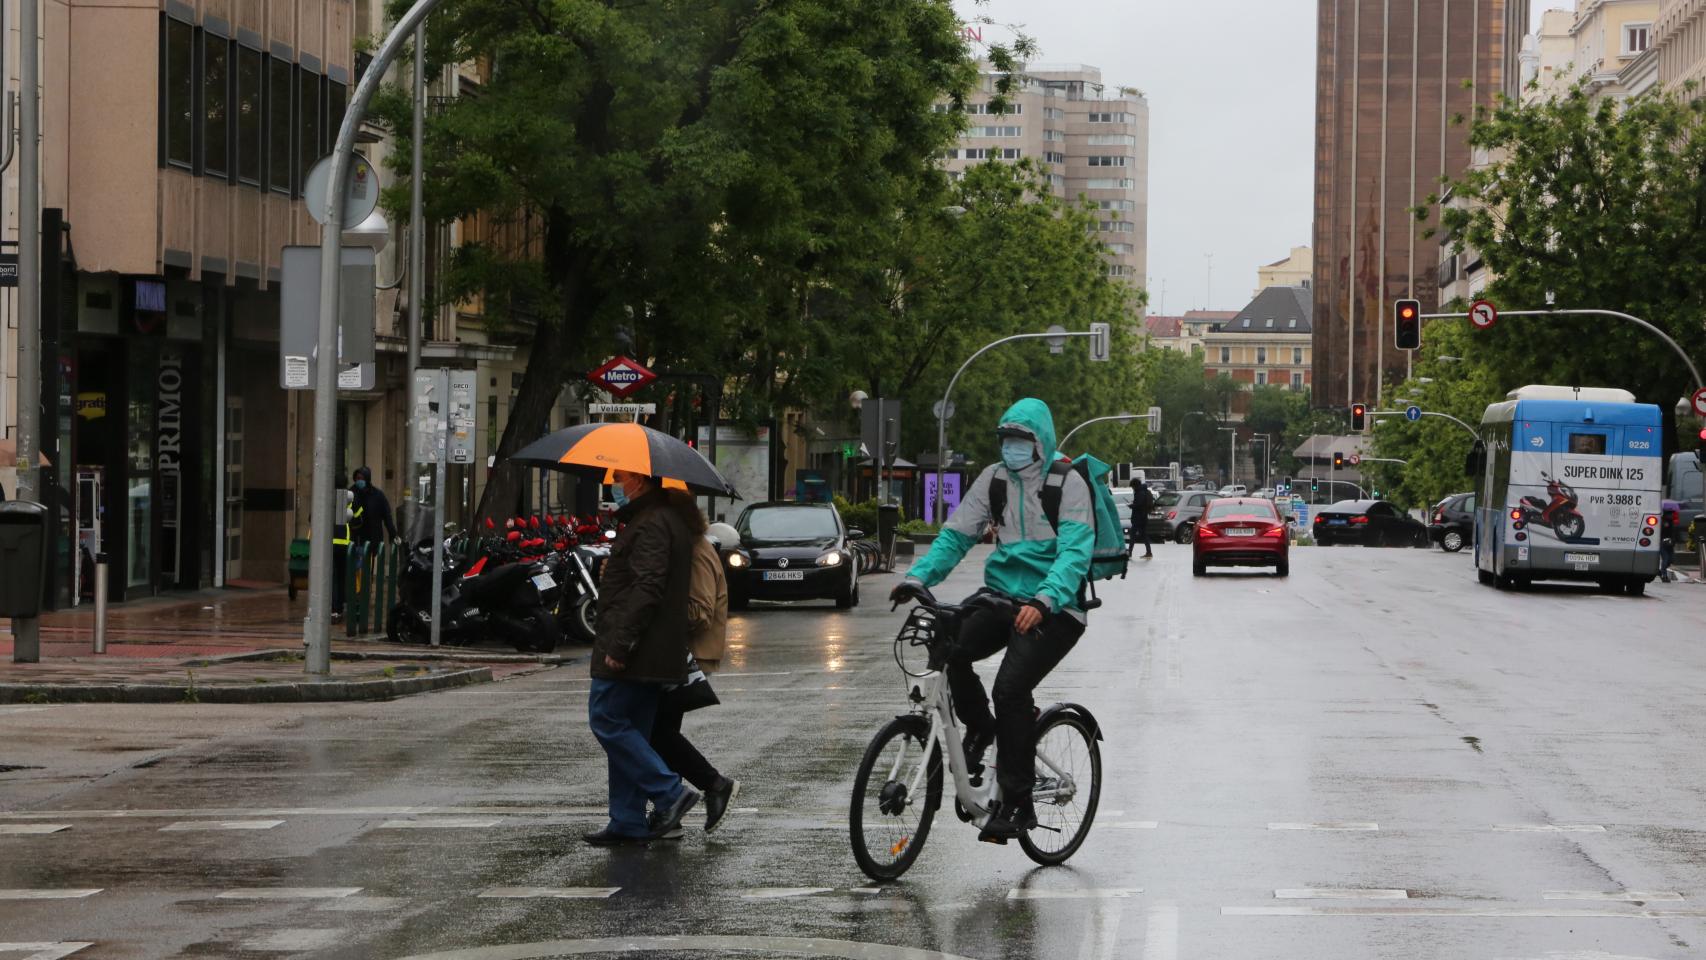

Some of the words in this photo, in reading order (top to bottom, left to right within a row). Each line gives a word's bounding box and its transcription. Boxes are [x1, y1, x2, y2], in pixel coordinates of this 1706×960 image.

[607, 371, 637, 381] Metro
[1629, 440, 1650, 449] 9226
[1564, 465, 1597, 479] SUPER
[1599, 467, 1623, 480] DINK
[1626, 468, 1644, 481] 125
[1590, 495, 1605, 504] PVR
[1607, 494, 1634, 505] 3.988
